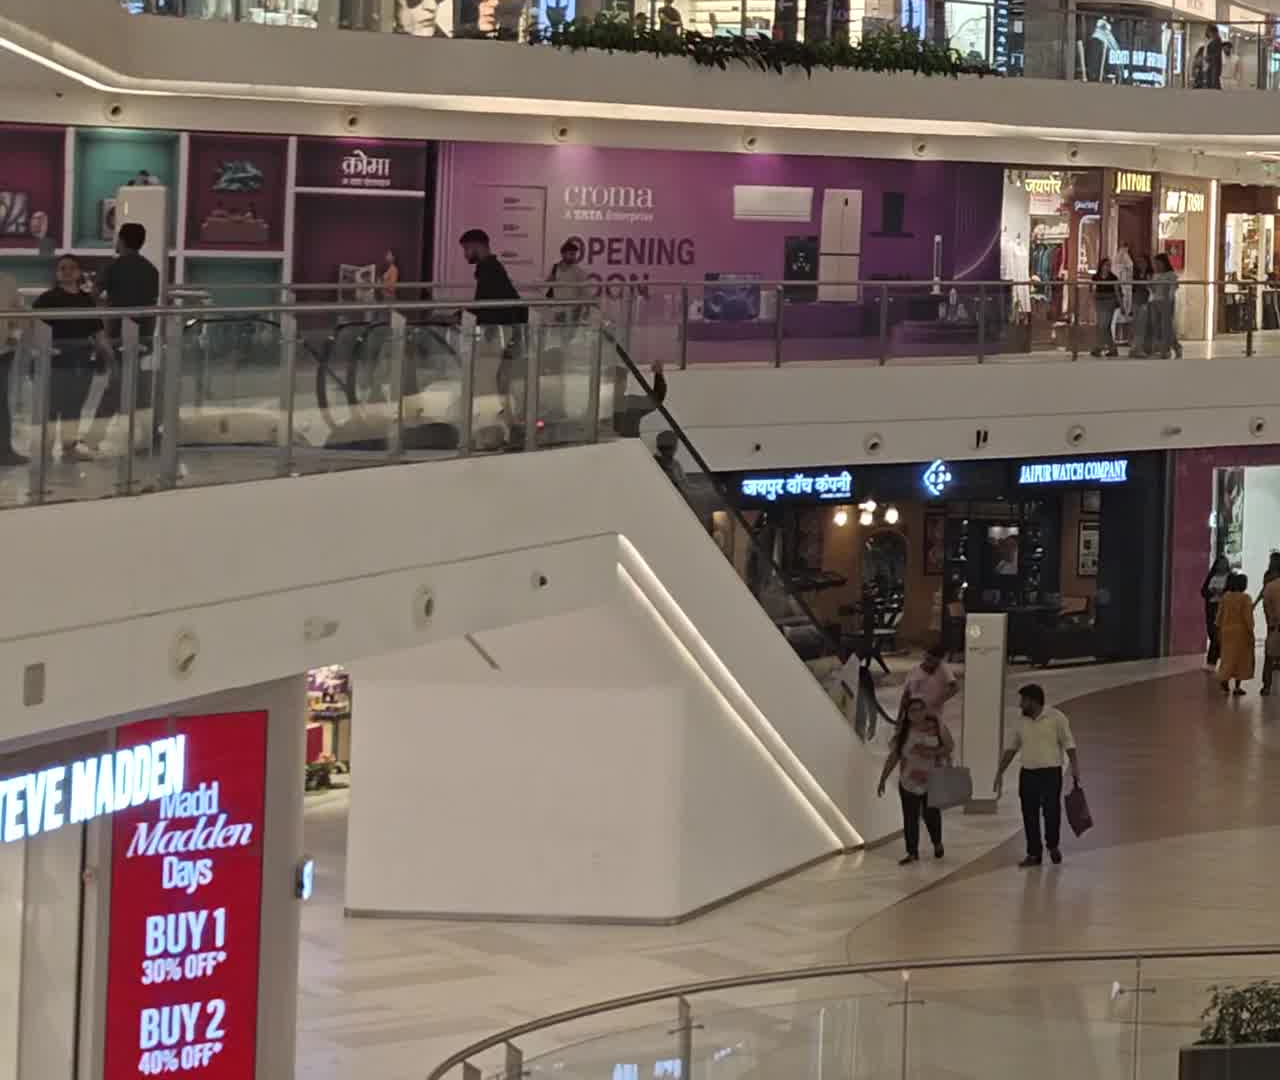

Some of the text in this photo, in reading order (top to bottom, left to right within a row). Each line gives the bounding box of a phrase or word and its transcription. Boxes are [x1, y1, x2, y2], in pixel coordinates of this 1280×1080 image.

[564, 185, 653, 208] croma
[1115, 172, 1152, 194] JAYPORE
[559, 237, 695, 265] OPENING
[1019, 460, 1128, 483] JAIPUR WATCH COMPANY
[742, 478, 784, 501] जयपुर
[0, 734, 187, 843] TEVE MADDEN
[160, 781, 219, 819] Madd
[126, 813, 254, 858] Madden
[162, 855, 213, 894] Days
[145, 907, 226, 957] BUY 1
[141, 956, 183, 985] 30%
[139, 998, 226, 1049] BUY 2
[138, 1049, 179, 1075] 40%
